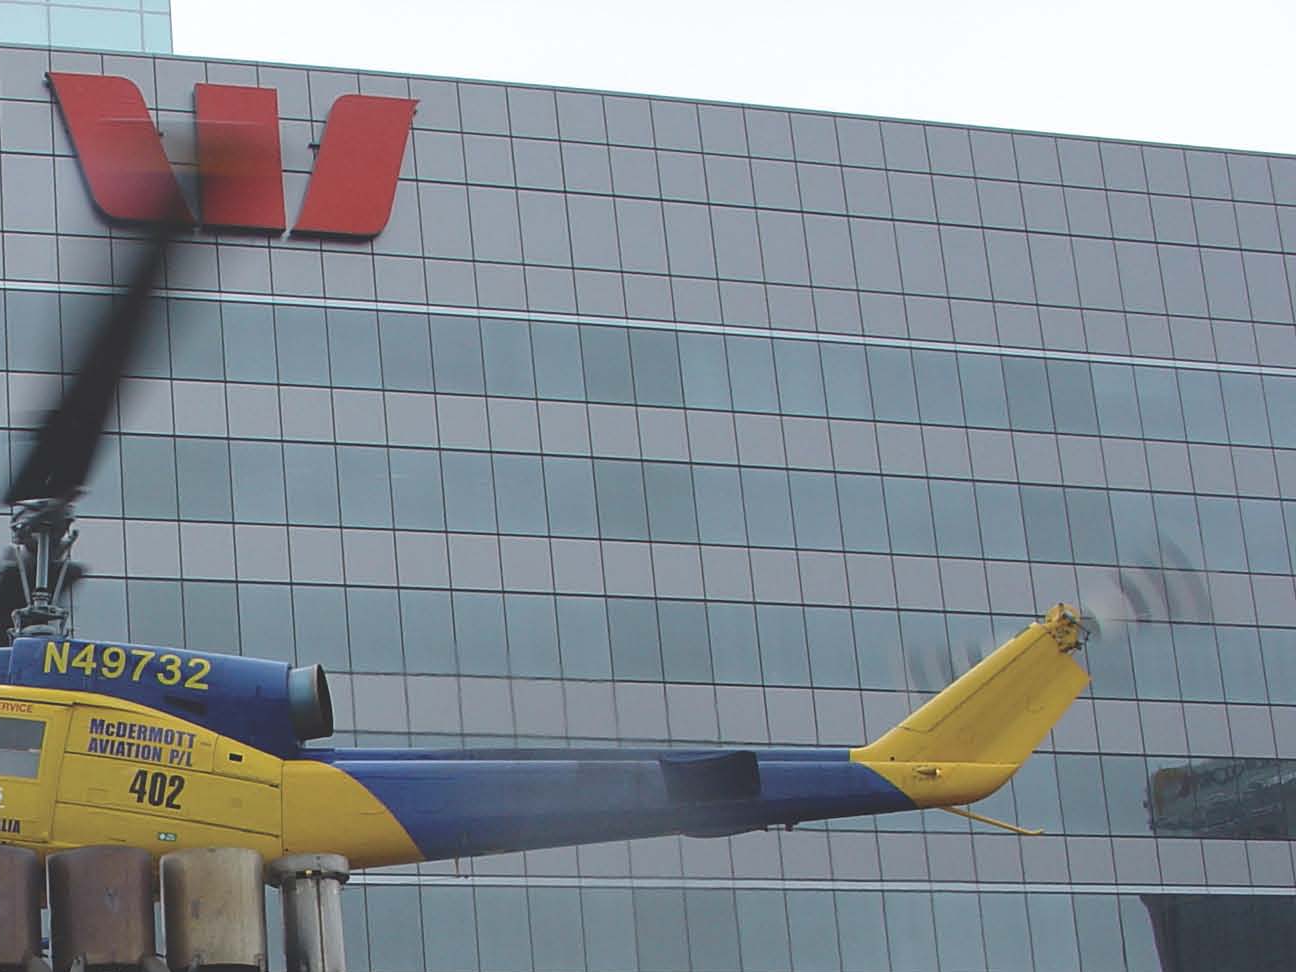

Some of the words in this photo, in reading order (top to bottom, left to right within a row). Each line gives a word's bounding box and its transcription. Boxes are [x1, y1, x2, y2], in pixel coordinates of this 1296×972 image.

[43, 641, 211, 691] N49732
[89, 718, 197, 749] McDERMOTT
[88, 738, 163, 763] AVIATION
[168, 750, 193, 768] P/L
[129, 768, 185, 810] 402
